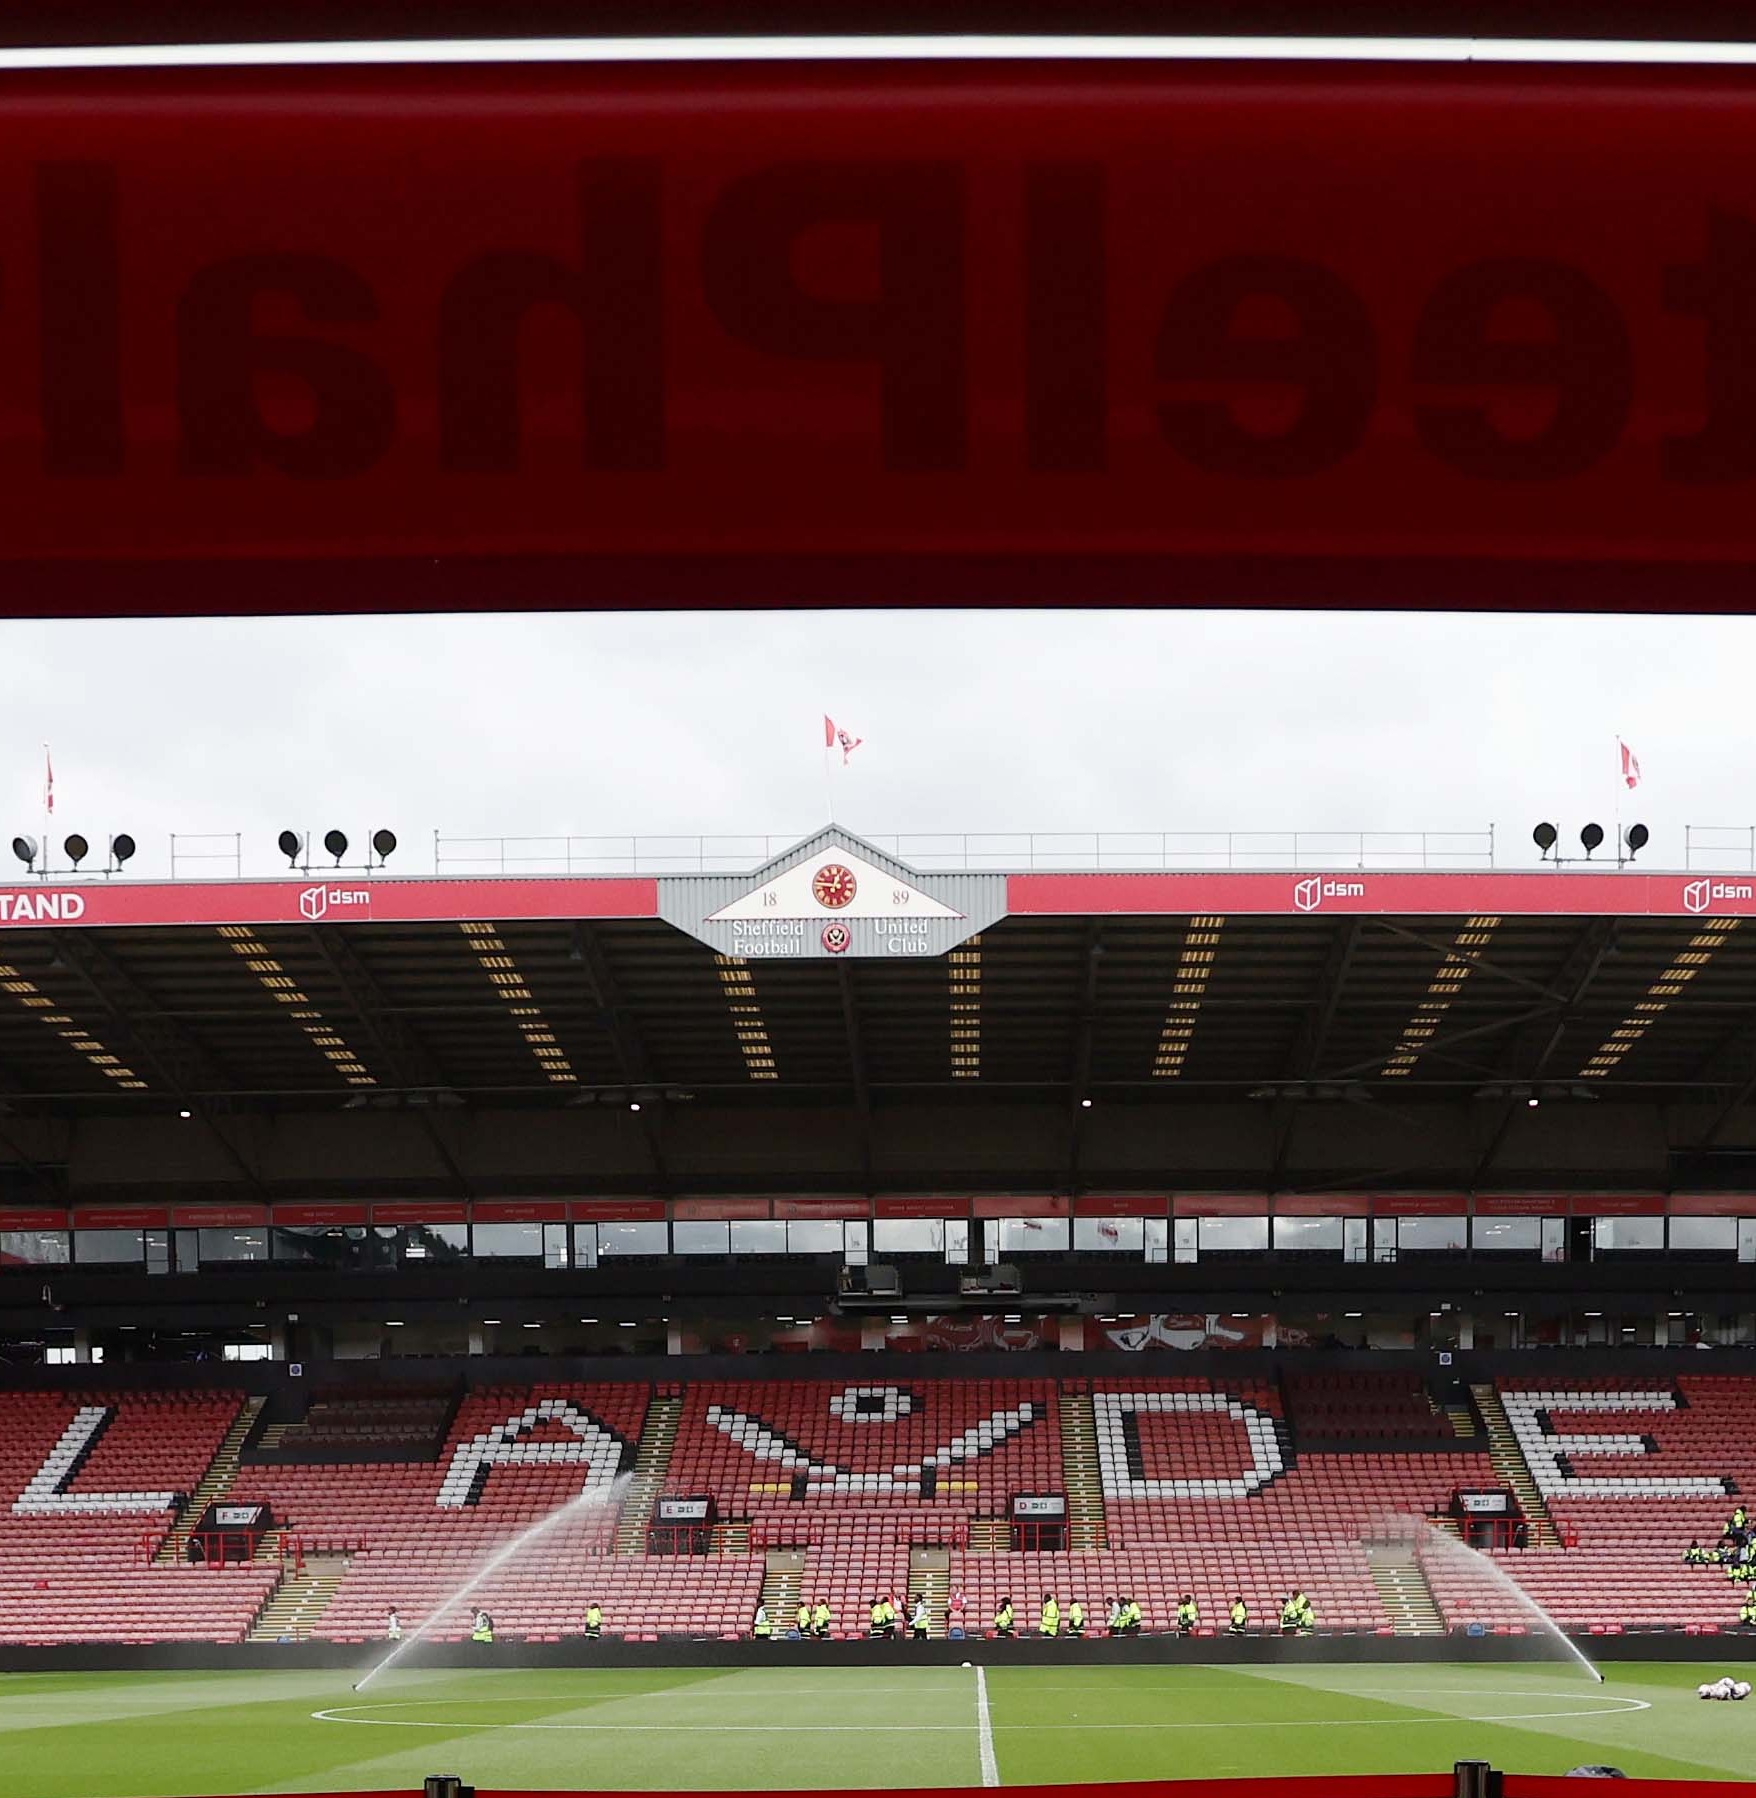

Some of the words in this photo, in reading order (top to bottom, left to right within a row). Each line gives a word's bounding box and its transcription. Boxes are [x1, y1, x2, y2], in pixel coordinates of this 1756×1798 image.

[328, 888, 370, 905] dsm
[1323, 880, 1364, 897] dsm
[1712, 882, 1753, 899] dsm
[763, 892, 777, 906] 18
[892, 890, 910, 905] 89
[733, 920, 804, 936] Sheffield
[874, 919, 928, 935] United
[734, 939, 800, 955] Football
[888, 938, 928, 953] Club
